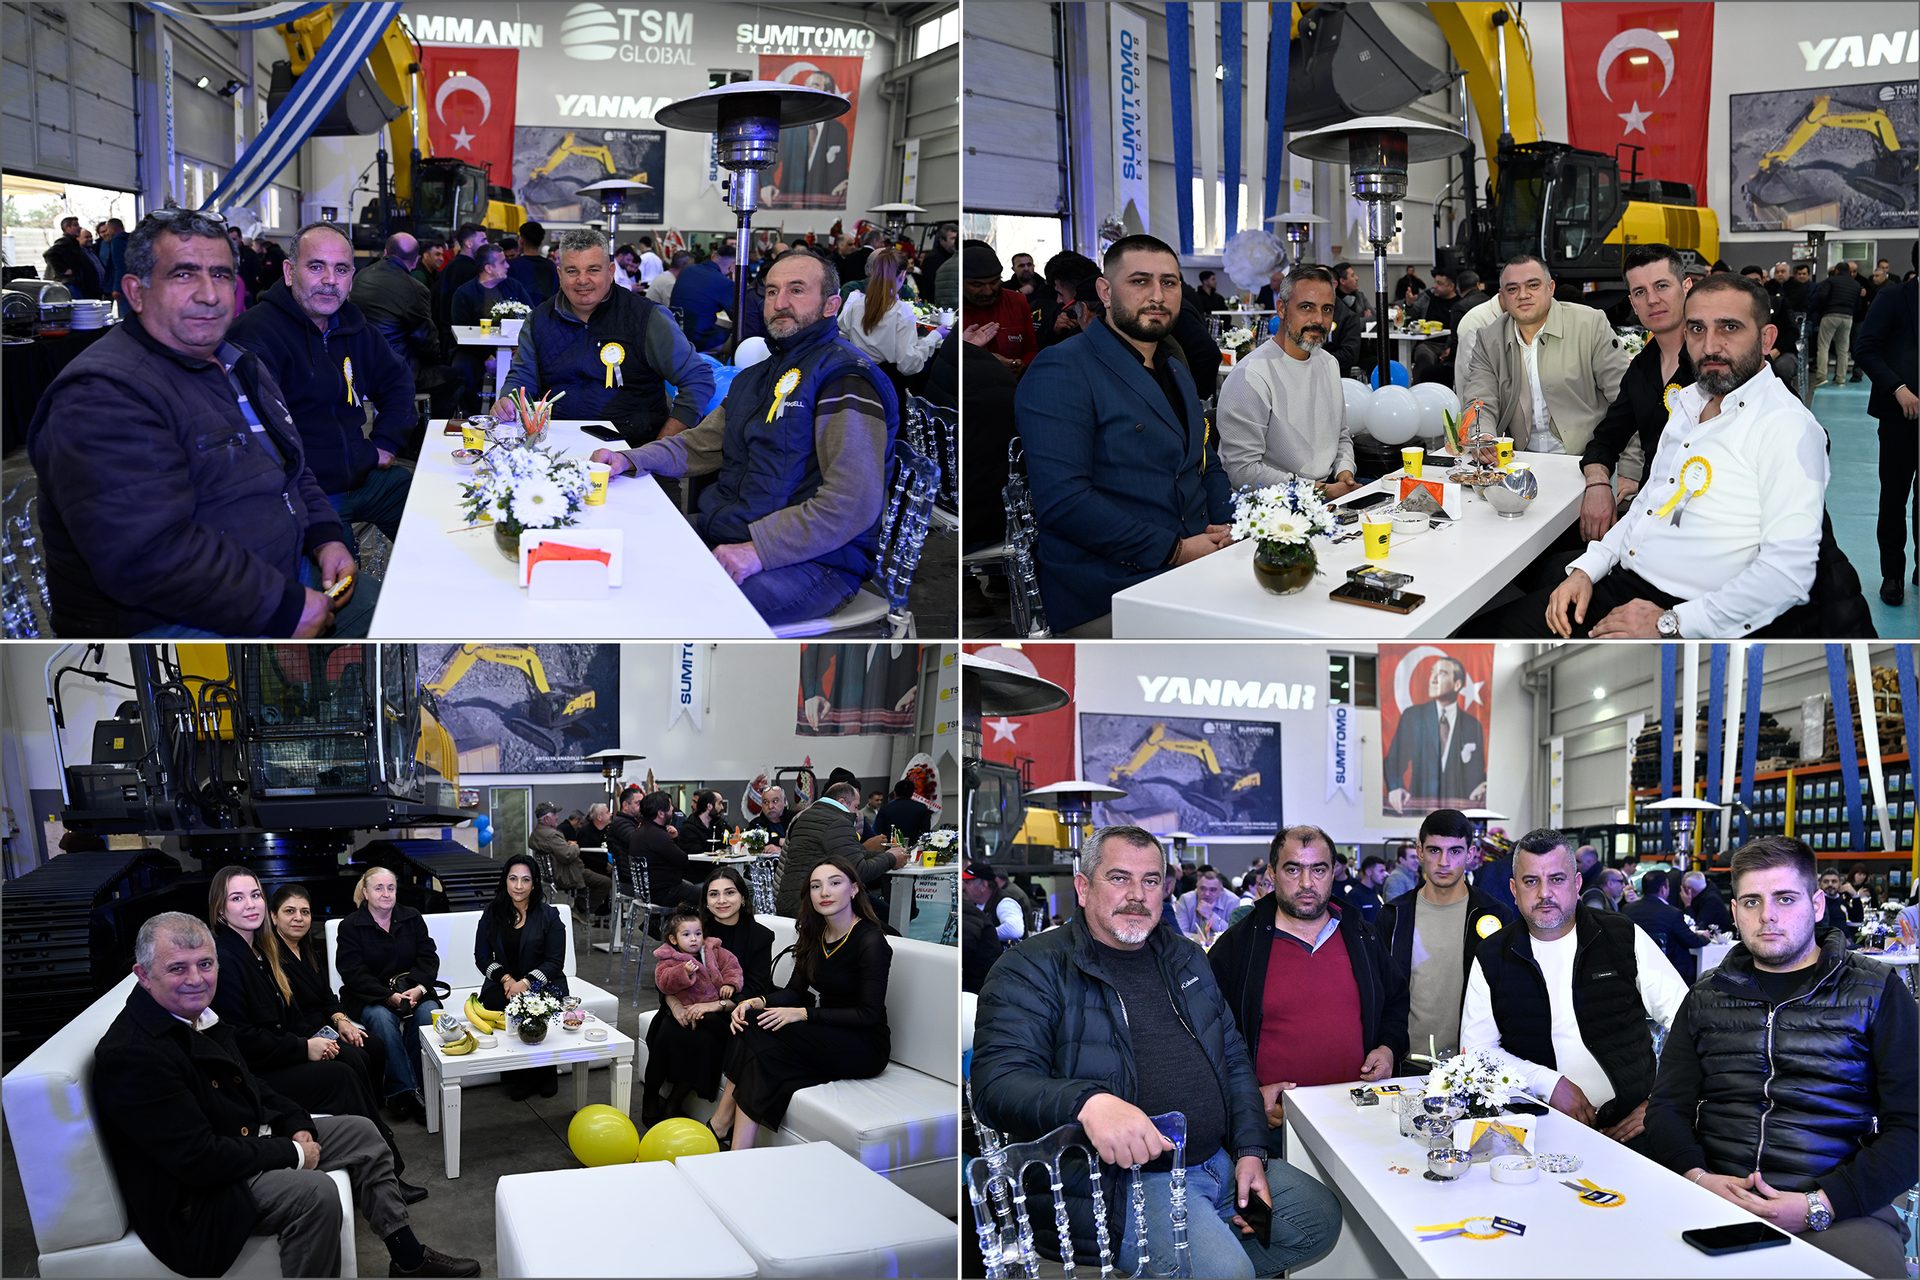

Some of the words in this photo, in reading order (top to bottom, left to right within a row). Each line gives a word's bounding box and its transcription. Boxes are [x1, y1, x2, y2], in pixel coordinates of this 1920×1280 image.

[617, 8, 693, 45] TSM
[736, 23, 876, 50] SUMITOMO
[619, 44, 697, 66] GLOBAL
[1120, 29, 1135, 180] SUMITOMO
[1895, 84, 1917, 95] TSM
[1133, 36, 1143, 180] EXCAVATORS
[1136, 675, 1316, 710] YANMAR
[1336, 707, 1347, 784] SUMITOMO
